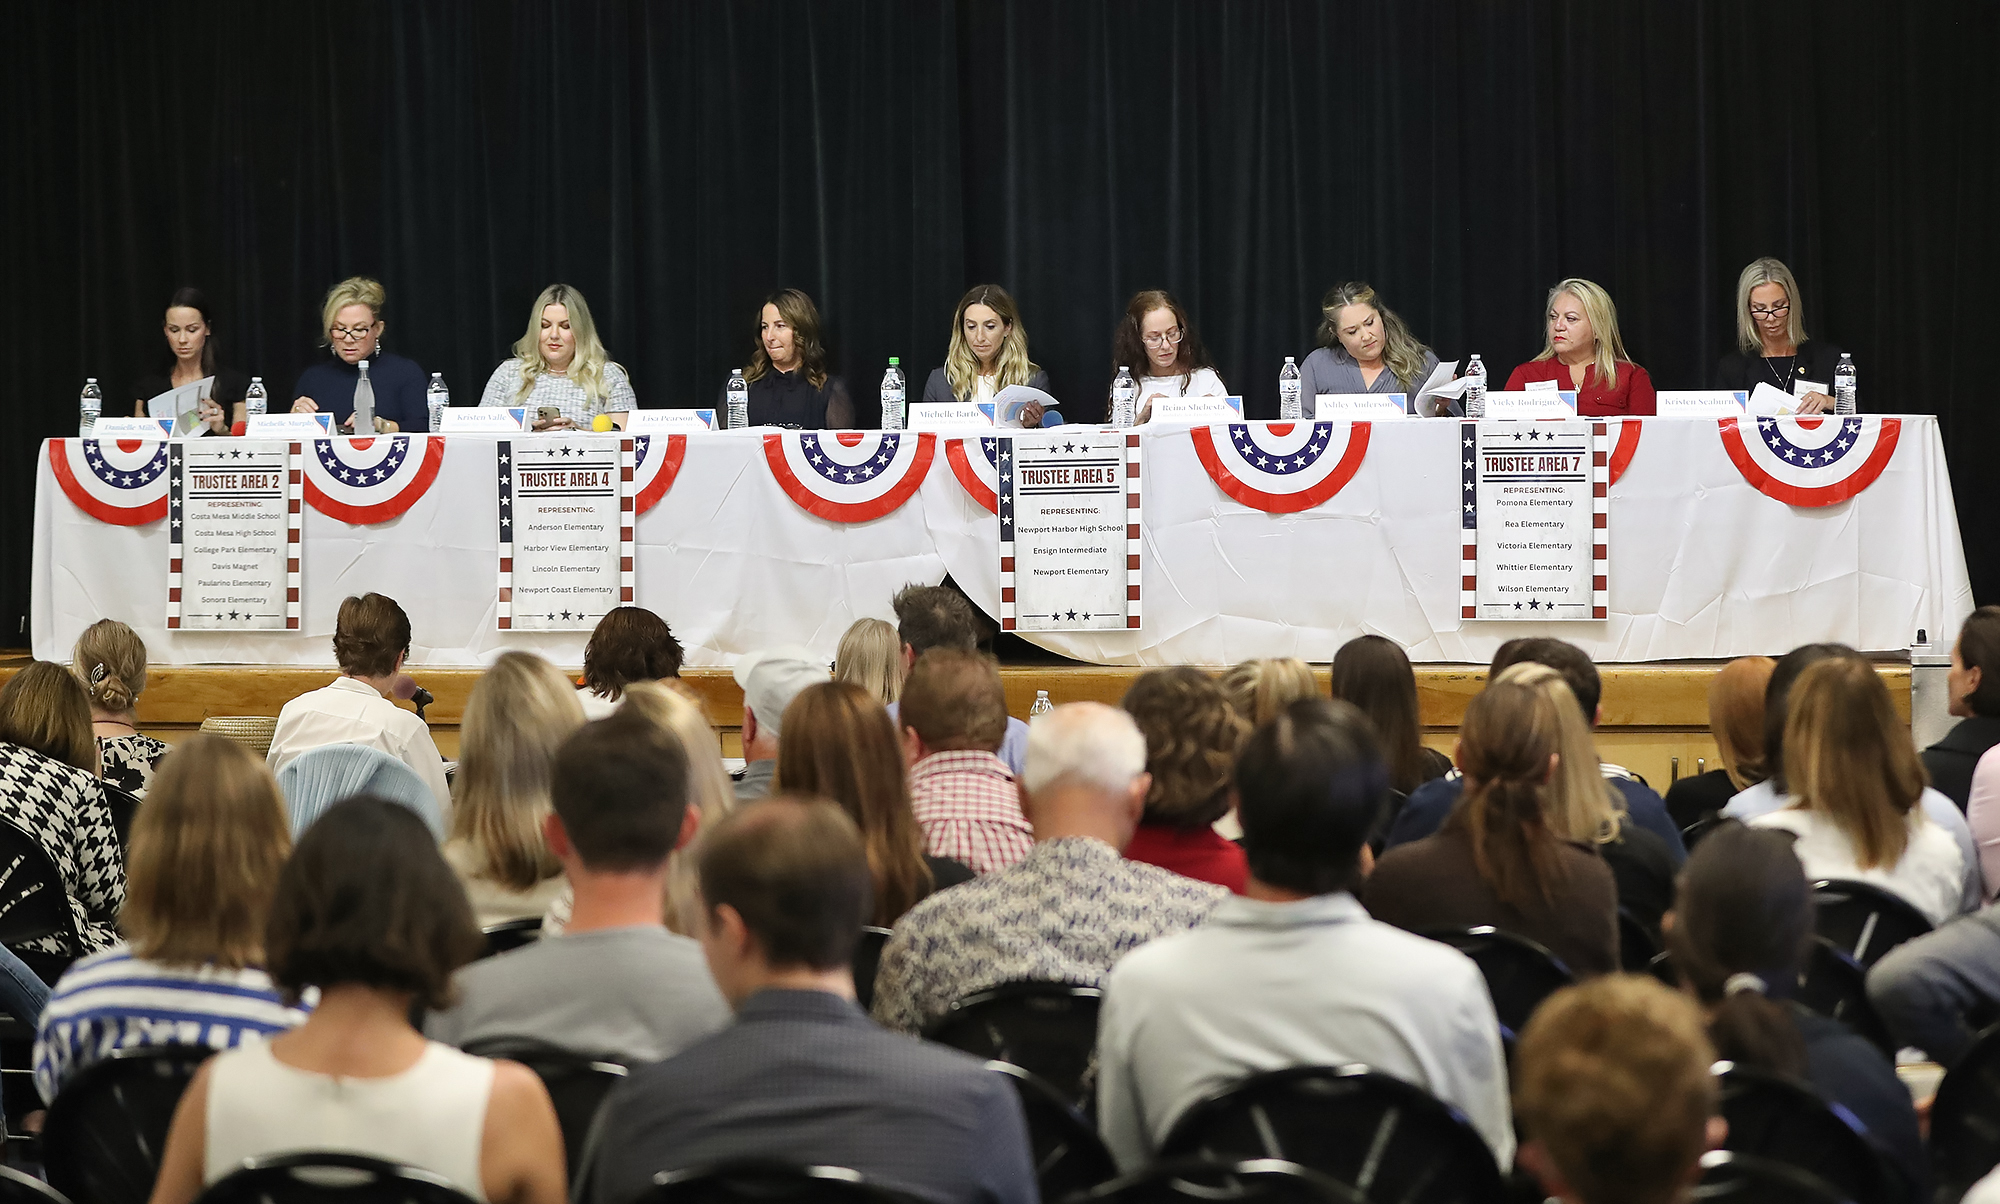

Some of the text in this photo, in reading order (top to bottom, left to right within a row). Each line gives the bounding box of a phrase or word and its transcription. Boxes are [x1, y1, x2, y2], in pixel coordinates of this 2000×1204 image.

[1485, 457, 1581, 472] TRUSTEE AREA 7
[520, 472, 609, 487] TRUSTEE AREA 4
[1021, 468, 1115, 485] TRUSTEE AREA 5
[193, 475, 280, 489] TRUSTEE AREA 2
[232, 512, 256, 520] Middle
[257, 512, 281, 520] School
[564, 524, 605, 532] Elementary
[1521, 521, 1565, 529] Elementary
[235, 529, 252, 538] High
[253, 529, 277, 537] School
[1018, 526, 1050, 534] Newport
[1080, 525, 1097, 534] High
[569, 545, 609, 553] Elementary
[1529, 542, 1573, 550] Elementary
[238, 547, 277, 555] Elementary
[233, 563, 259, 571] Magnet
[560, 566, 601, 574] Elementary
[1529, 564, 1573, 572] Elementary
[1033, 568, 1110, 577] Newport Elementary
[232, 580, 272, 588] Elementary
[573, 586, 614, 595] Elementary
[1526, 585, 1569, 594] Elementary
[228, 596, 267, 605] Elementary
